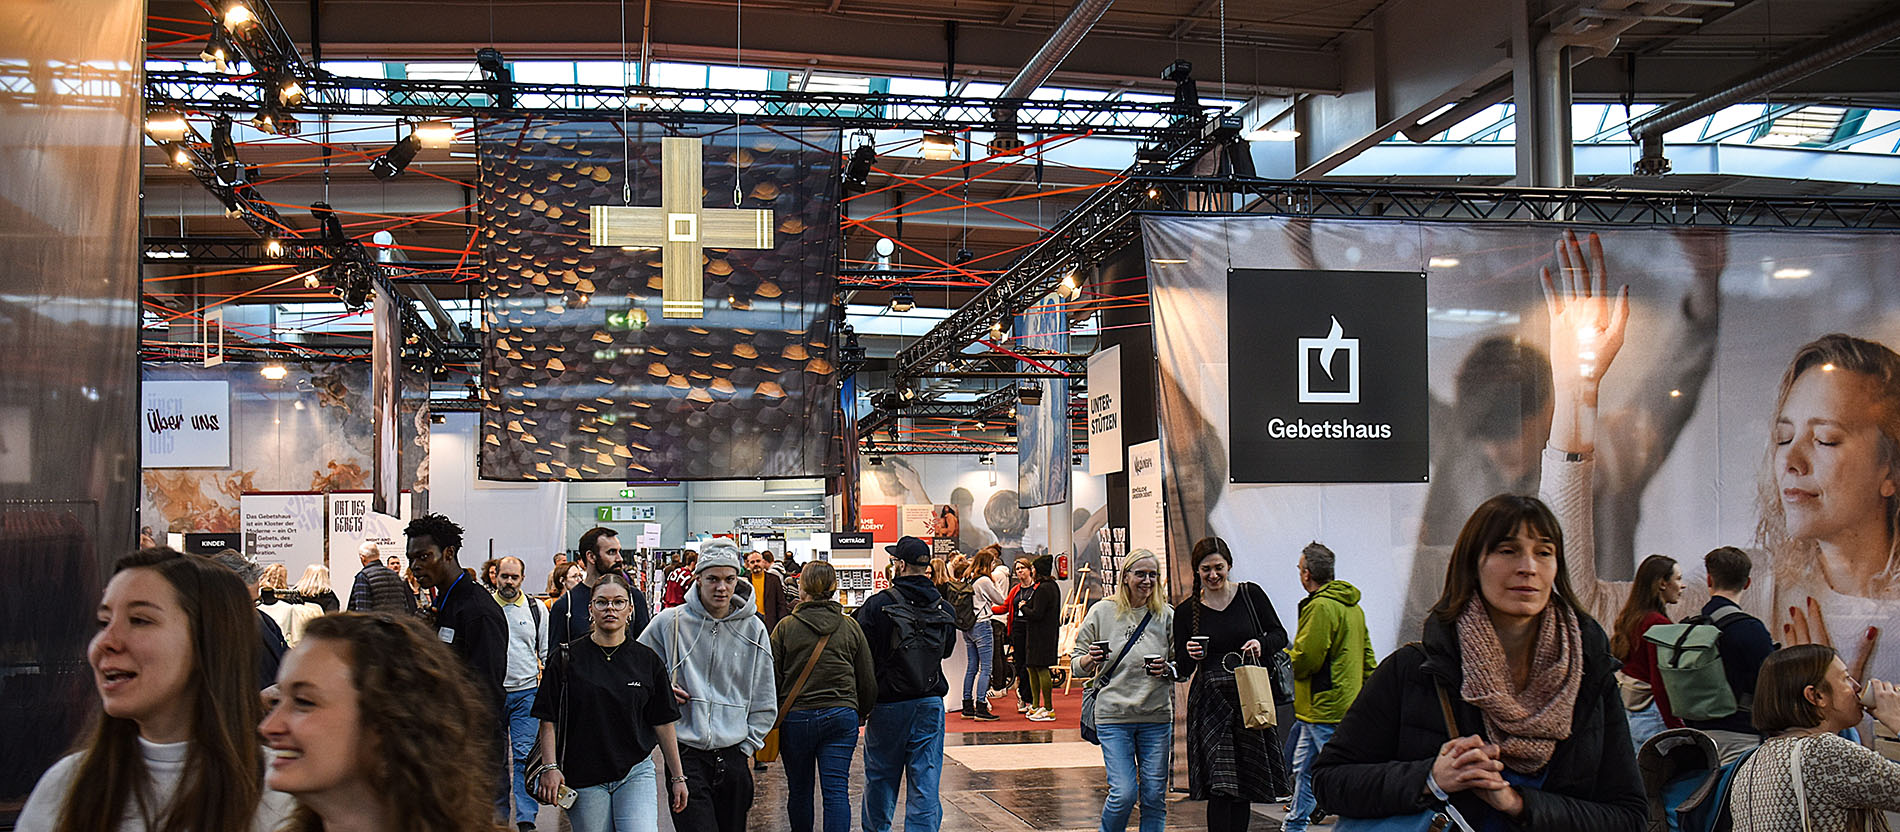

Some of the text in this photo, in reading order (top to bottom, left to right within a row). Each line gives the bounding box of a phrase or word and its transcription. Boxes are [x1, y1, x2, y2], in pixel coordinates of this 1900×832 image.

[1090, 393, 1112, 414] UNTER-
[147, 408, 184, 434] Über
[1091, 412, 1117, 435] STÜTZEN
[1268, 418, 1392, 439] Gebetshaus
[334, 500, 348, 515] ORT
[351, 500, 366, 515] DES
[601, 508, 609, 519] 7
[334, 516, 363, 532] GEBETS
